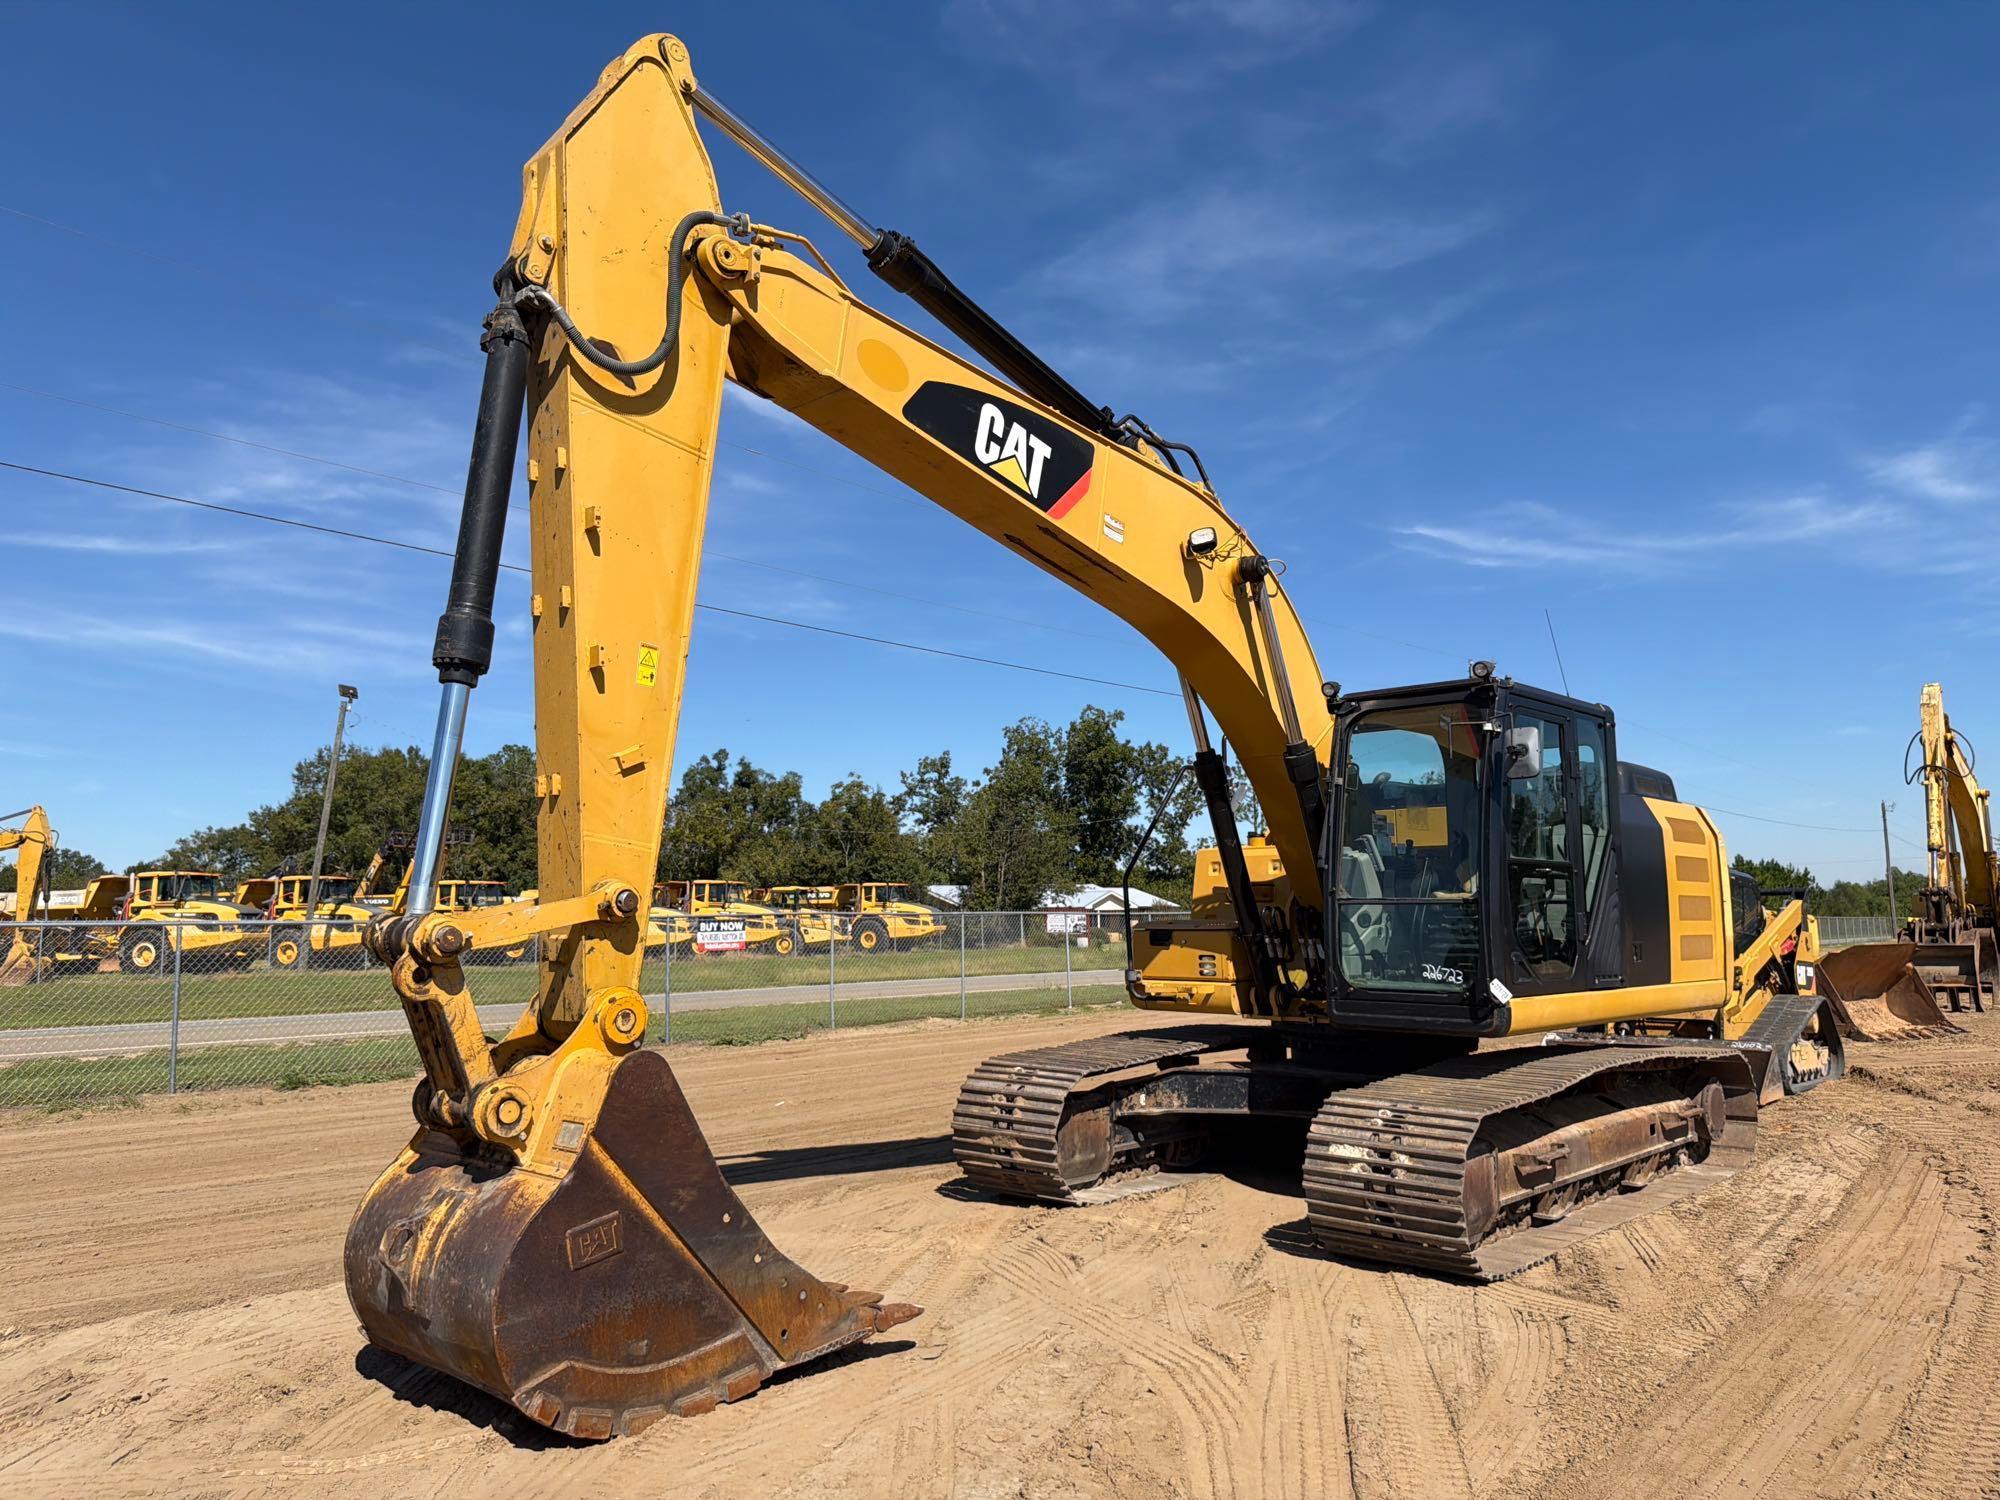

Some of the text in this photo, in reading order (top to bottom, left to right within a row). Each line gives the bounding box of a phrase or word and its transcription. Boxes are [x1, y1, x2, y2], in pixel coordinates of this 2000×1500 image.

[975, 402, 1052, 499] CAT
[700, 921, 744, 932] BUY NOW
[1421, 963, 1464, 984] 226723
